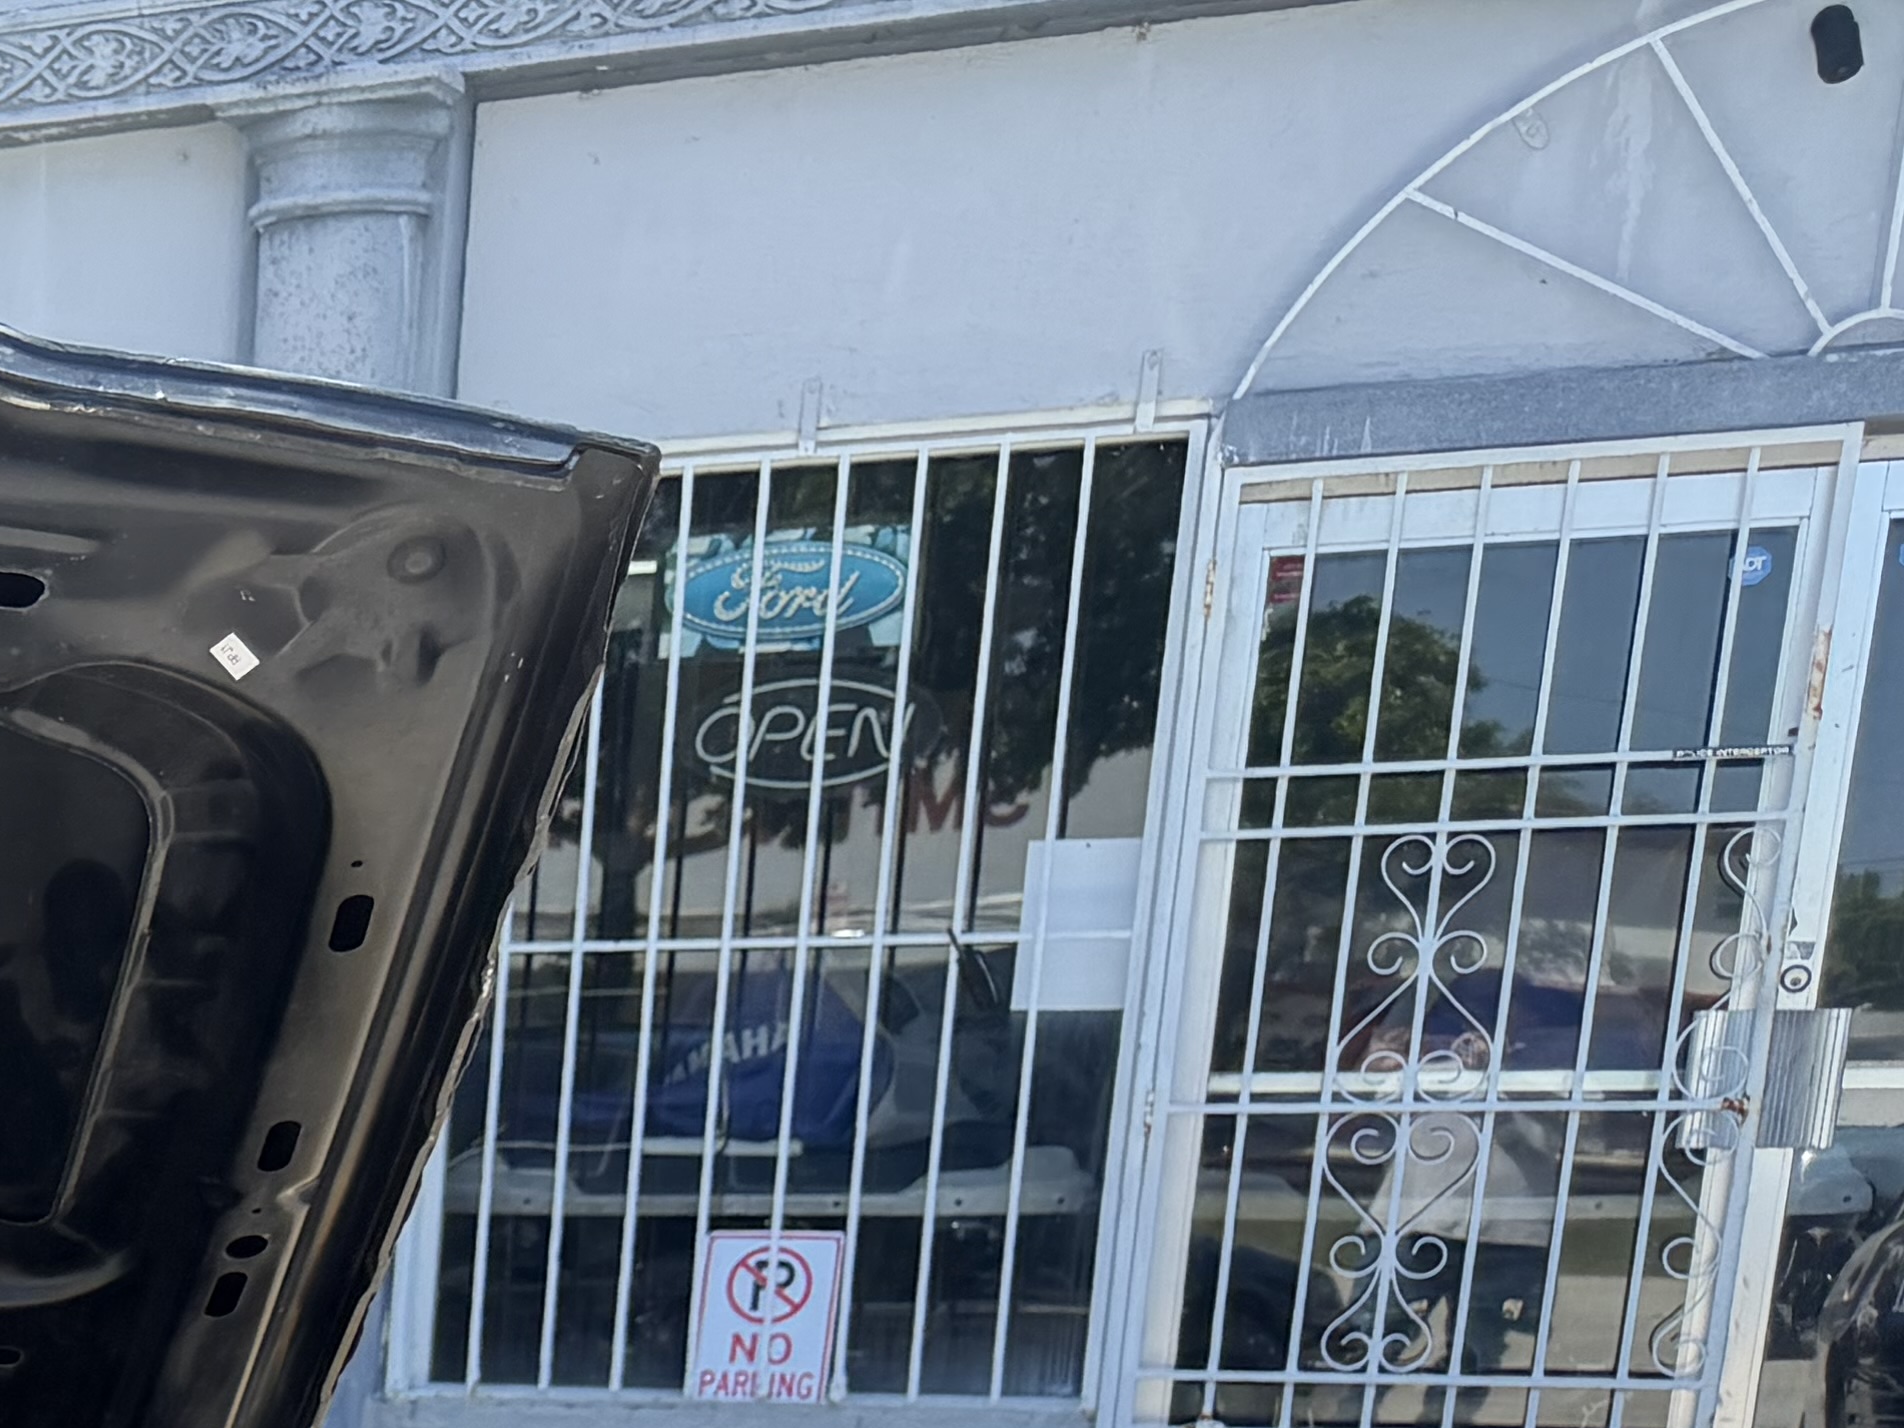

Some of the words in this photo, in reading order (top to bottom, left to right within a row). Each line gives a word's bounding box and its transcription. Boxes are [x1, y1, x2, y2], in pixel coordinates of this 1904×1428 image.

[713, 558, 861, 622] Ford
[695, 702, 915, 764] OPEN
[728, 1332, 793, 1365] NO
